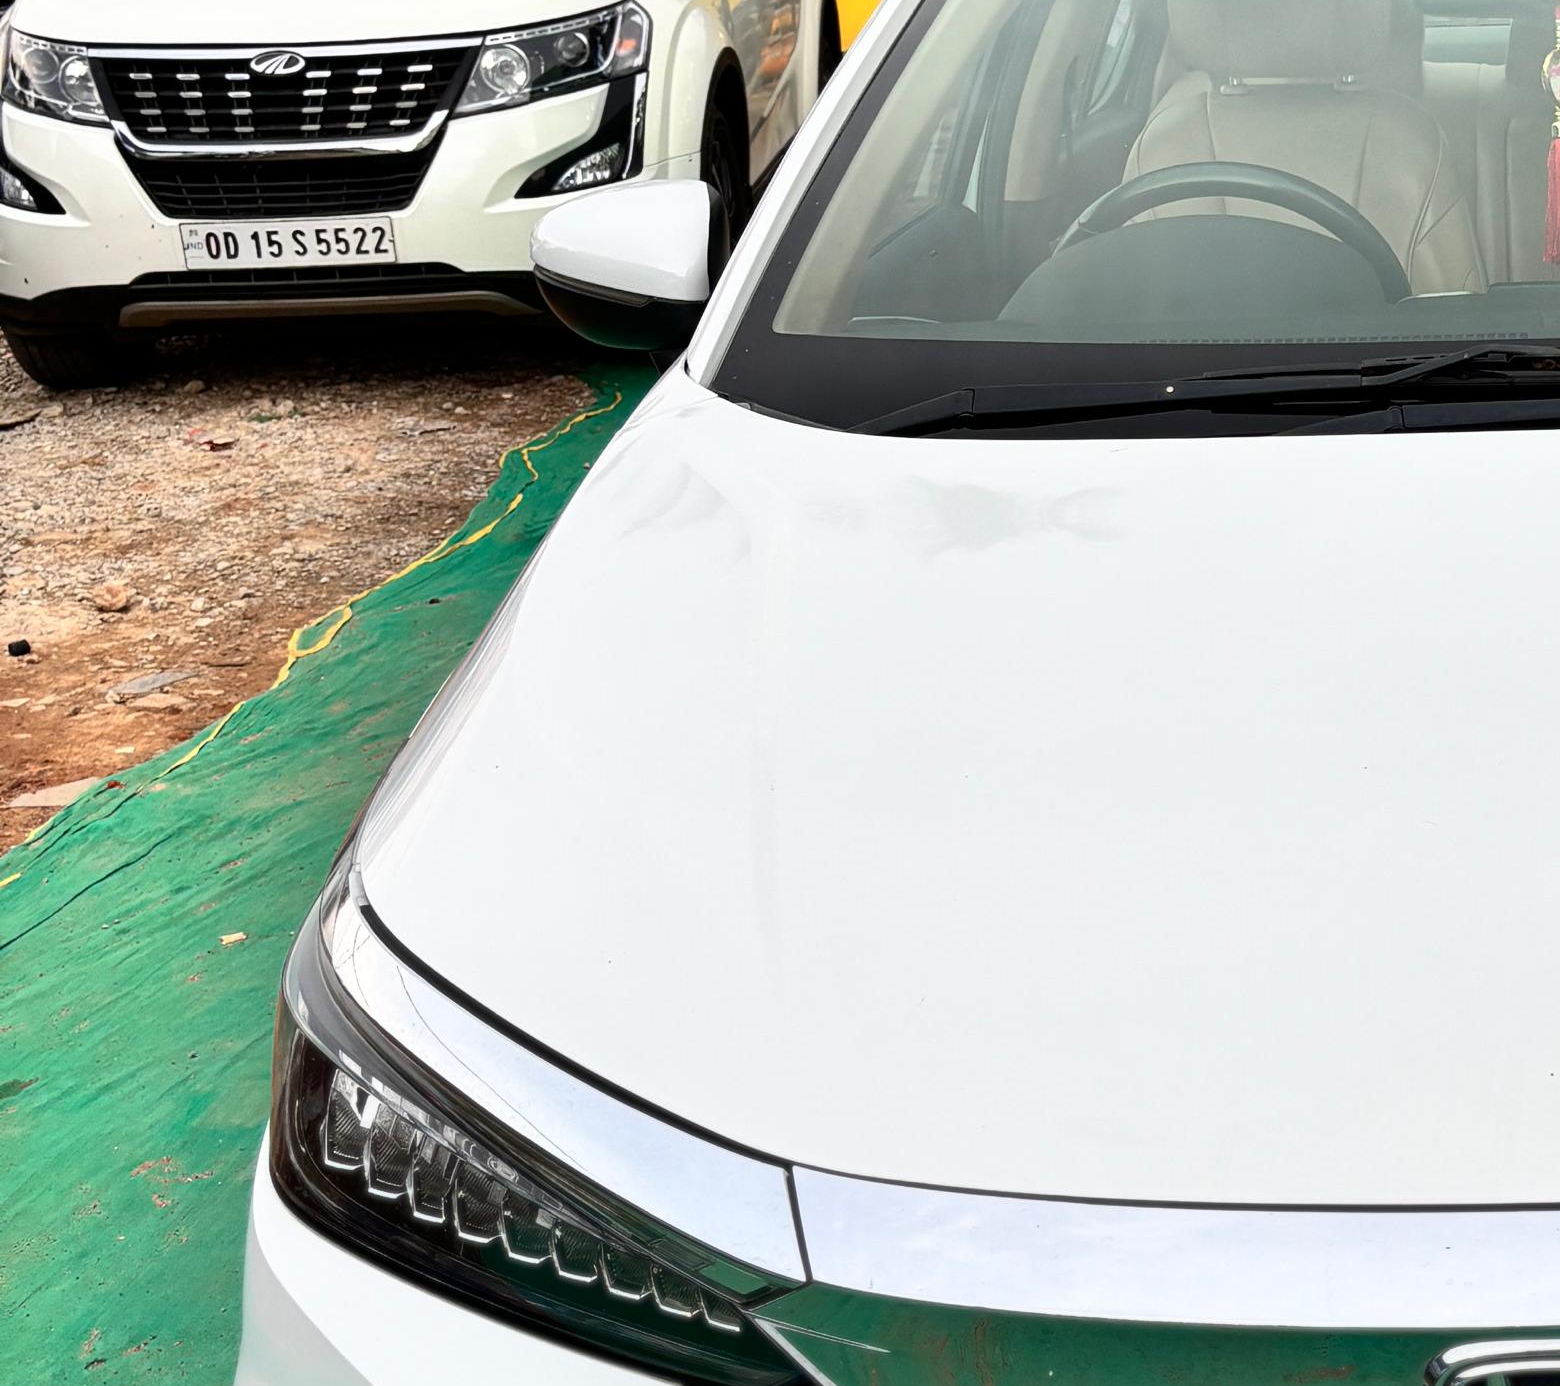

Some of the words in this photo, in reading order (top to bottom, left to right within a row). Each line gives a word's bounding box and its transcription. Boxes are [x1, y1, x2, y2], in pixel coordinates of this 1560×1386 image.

[204, 231, 240, 260] OD
[250, 230, 284, 259] 15
[291, 229, 309, 257] S
[314, 225, 390, 256] 5522
